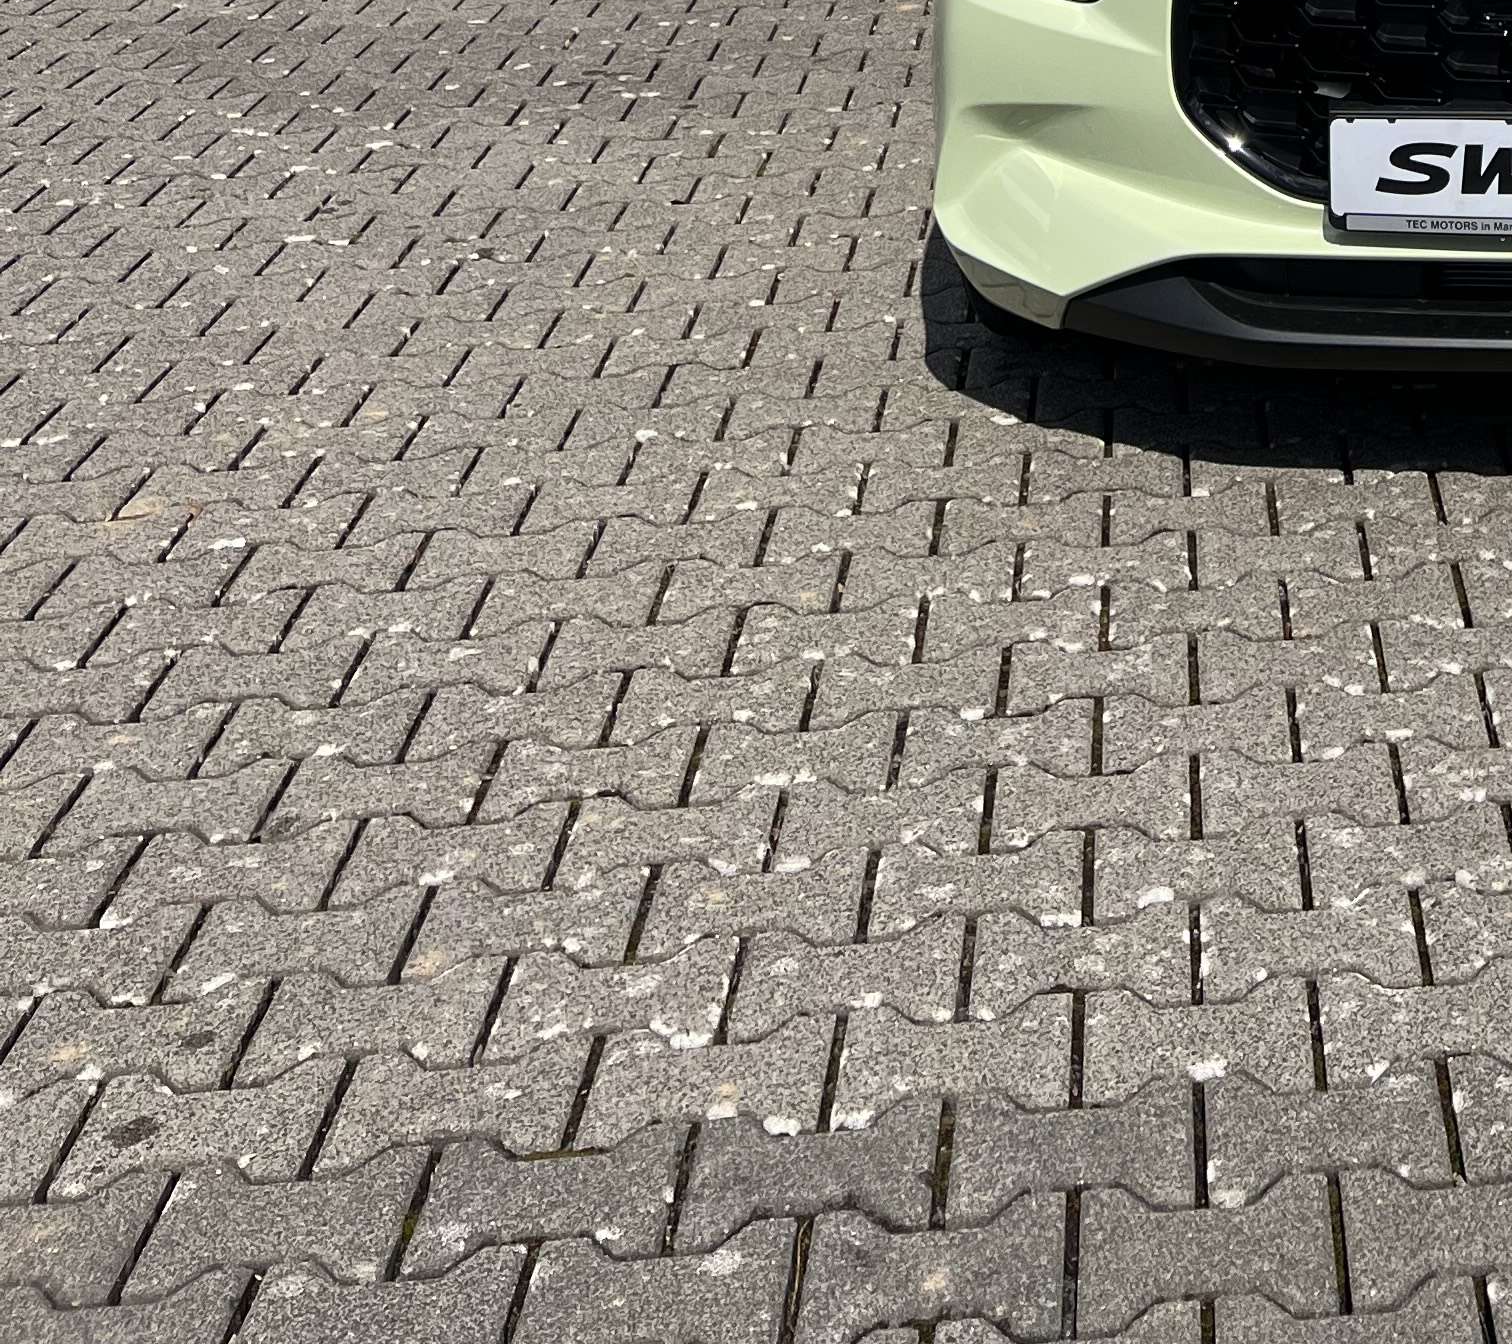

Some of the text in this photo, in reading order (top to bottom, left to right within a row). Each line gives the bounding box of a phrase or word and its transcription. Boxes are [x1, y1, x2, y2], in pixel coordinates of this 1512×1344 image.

[1406, 219, 1428, 229] TEC
[1430, 220, 1478, 231] MOTORS
[1481, 222, 1491, 231] in
